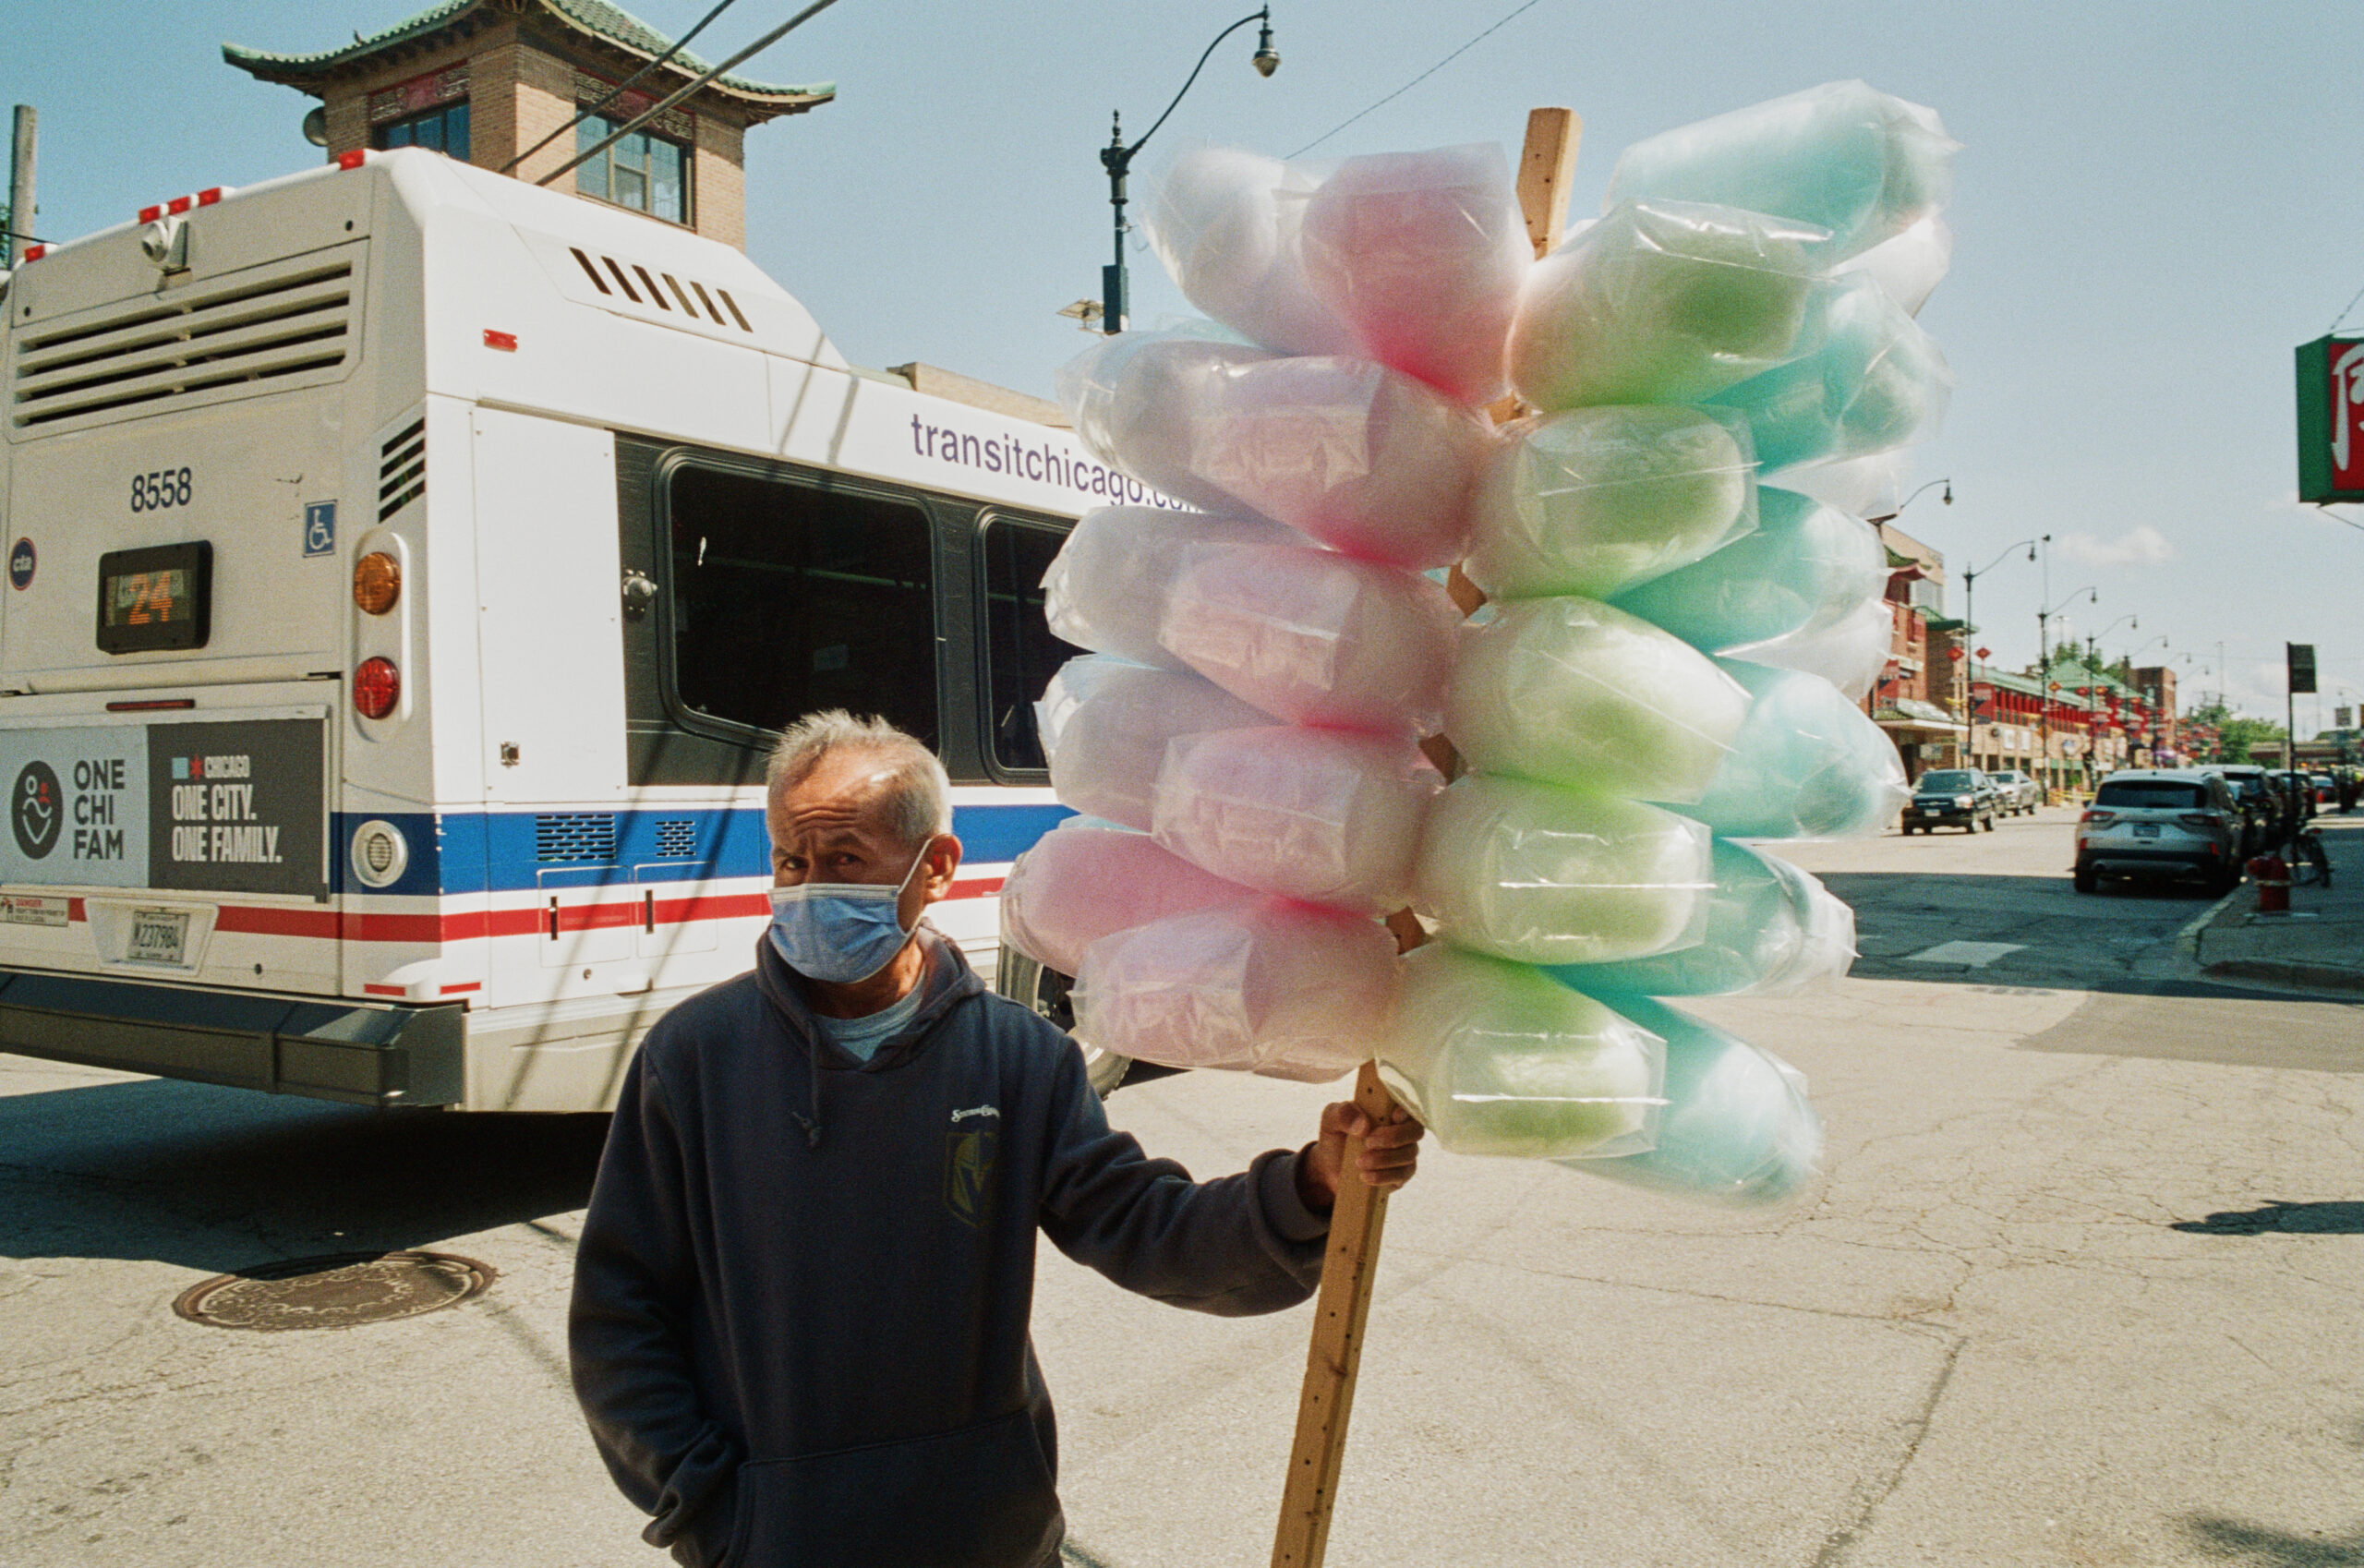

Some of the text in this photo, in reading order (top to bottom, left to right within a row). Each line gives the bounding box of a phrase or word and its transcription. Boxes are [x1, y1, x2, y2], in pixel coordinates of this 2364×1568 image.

[911, 414, 1200, 512] transitchicago.c
[131, 466, 192, 513] 8558
[128, 571, 173, 626] 24
[73, 759, 126, 790] ONE
[74, 794, 115, 826] CHI
[172, 784, 258, 821] ONE CITY.
[73, 829, 124, 860] FAM
[172, 826, 283, 862] ONE FAMILY.
